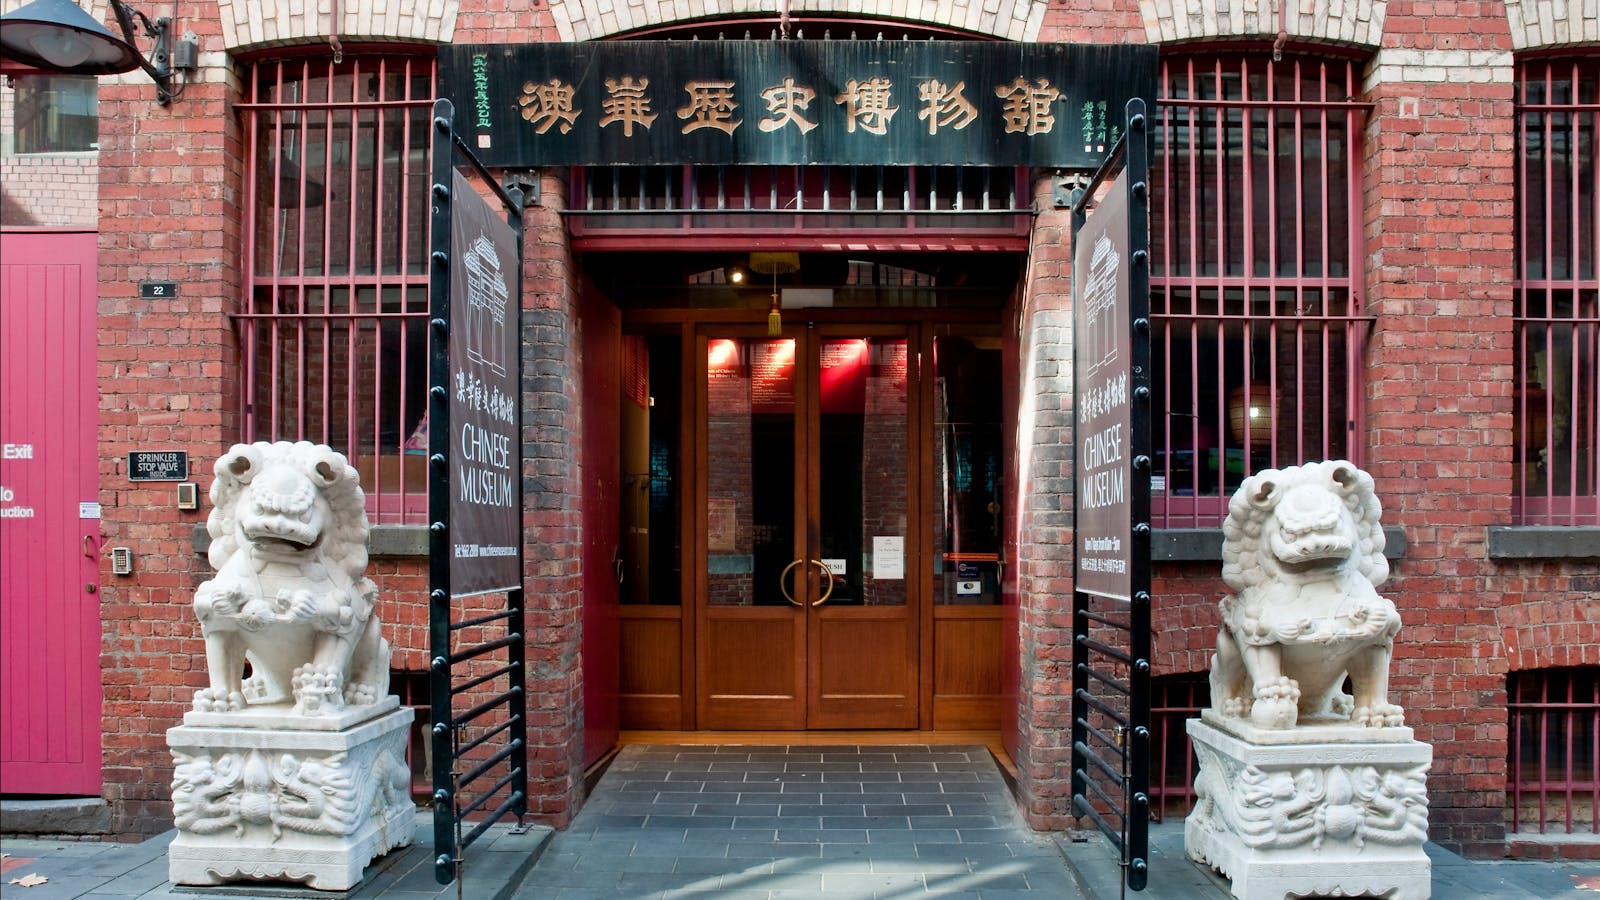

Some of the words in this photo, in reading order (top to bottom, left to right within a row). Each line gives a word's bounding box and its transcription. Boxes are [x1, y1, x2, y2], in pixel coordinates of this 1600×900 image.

[153, 286, 164, 295] 22
[3, 444, 33, 459] Exit
[137, 453, 177, 463] SPRINKLER
[462, 422, 510, 470] CHINESE
[1084, 423, 1122, 471] CHINESE
[137, 462, 156, 472] STOP
[157, 462, 178, 472] VALVE
[460, 464, 512, 508] MUSEUM
[1082, 466, 1124, 510] MUSEUM
